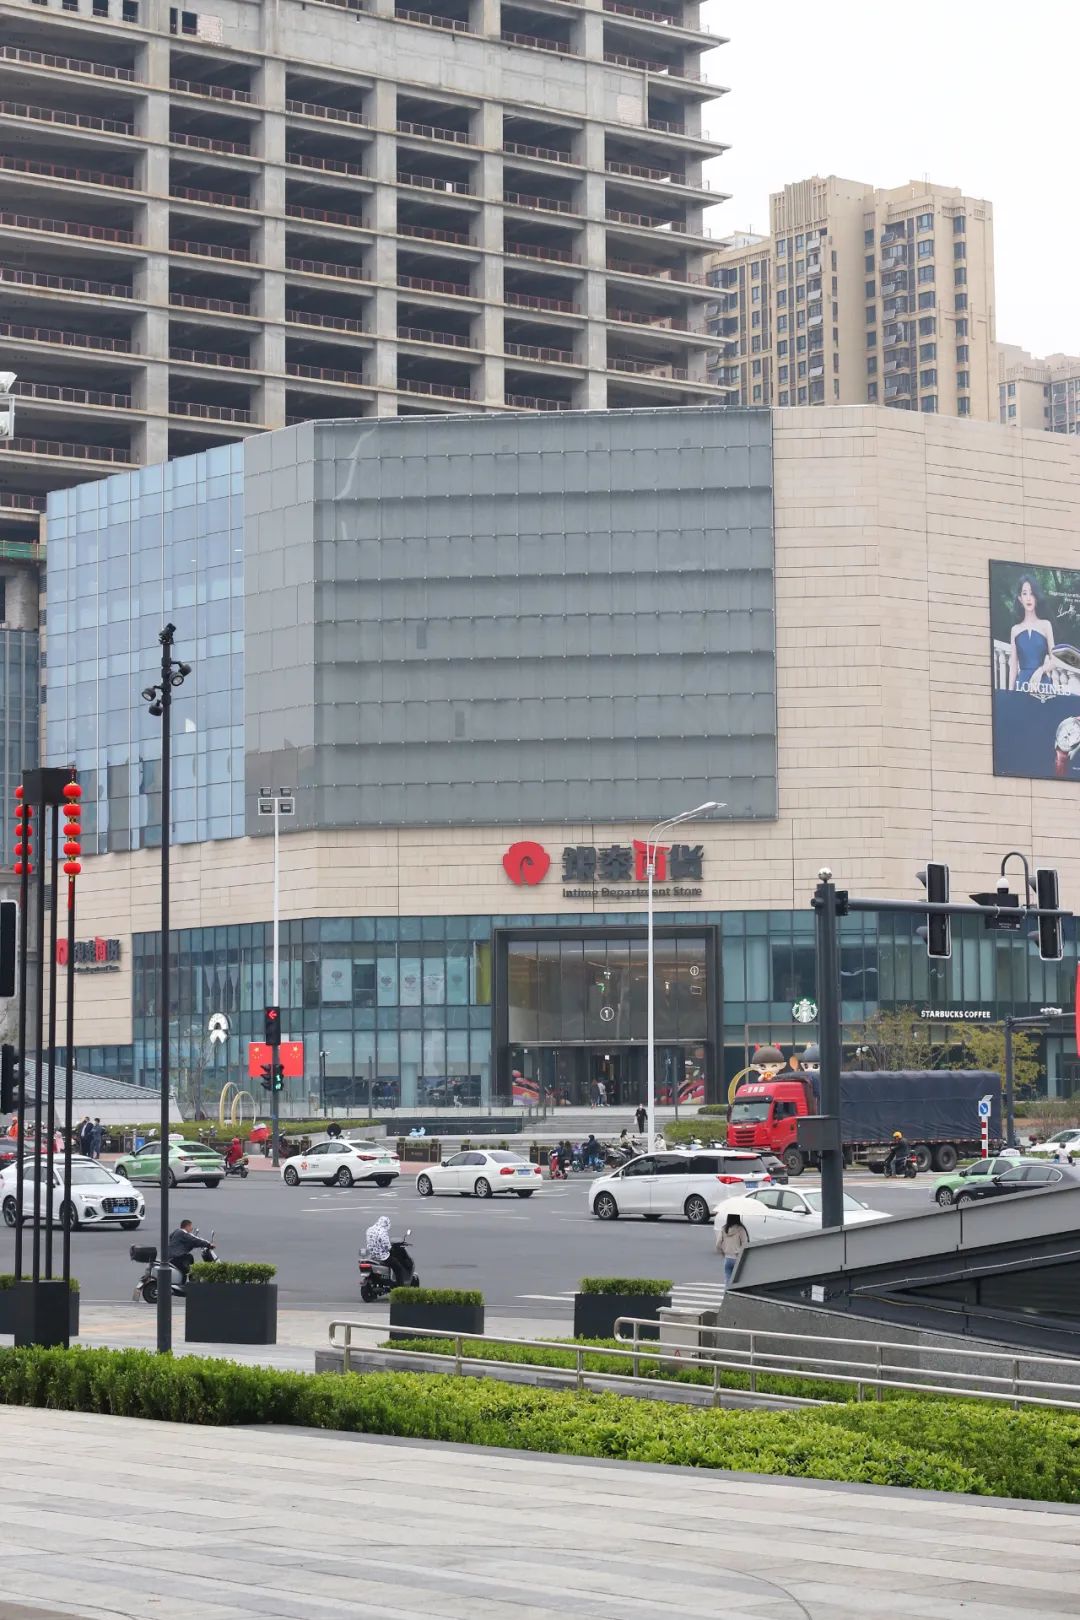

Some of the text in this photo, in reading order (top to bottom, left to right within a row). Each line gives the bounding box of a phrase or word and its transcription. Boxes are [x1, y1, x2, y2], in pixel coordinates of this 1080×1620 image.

[1016, 680, 1071, 696] LONGINES
[562, 888, 598, 898] Intime
[674, 887, 702, 896] Store
[921, 1010, 991, 1018] STARBUCKS COFFEE
